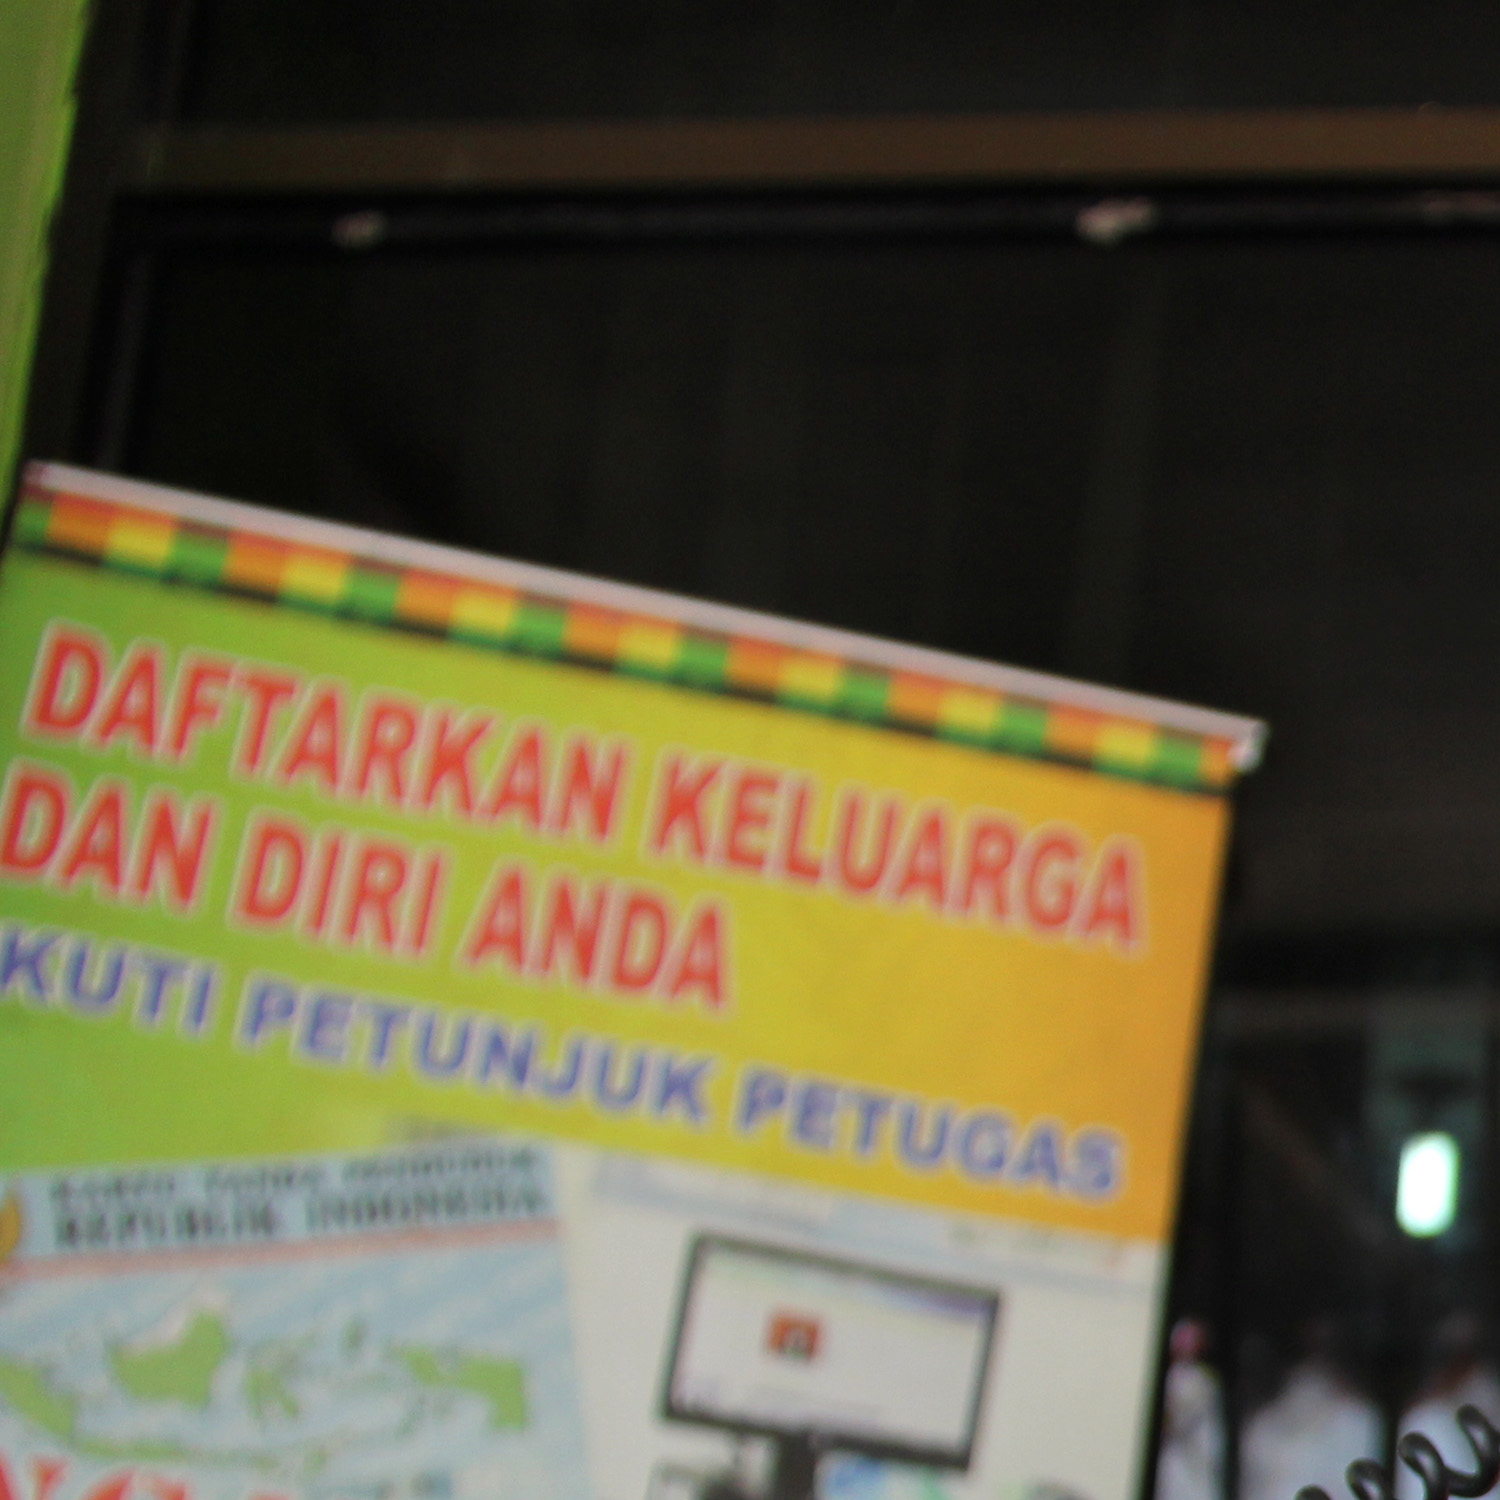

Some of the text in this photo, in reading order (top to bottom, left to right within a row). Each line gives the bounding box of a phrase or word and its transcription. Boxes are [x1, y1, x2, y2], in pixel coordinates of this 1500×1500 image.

[2, 768, 725, 1009] DAN DIRI ANDA
[28, 628, 1142, 950] DAFTARKAN KELUARGA
[241, 980, 709, 1121] PETUNJUK
[738, 1069, 1119, 1195] PETUGAS
